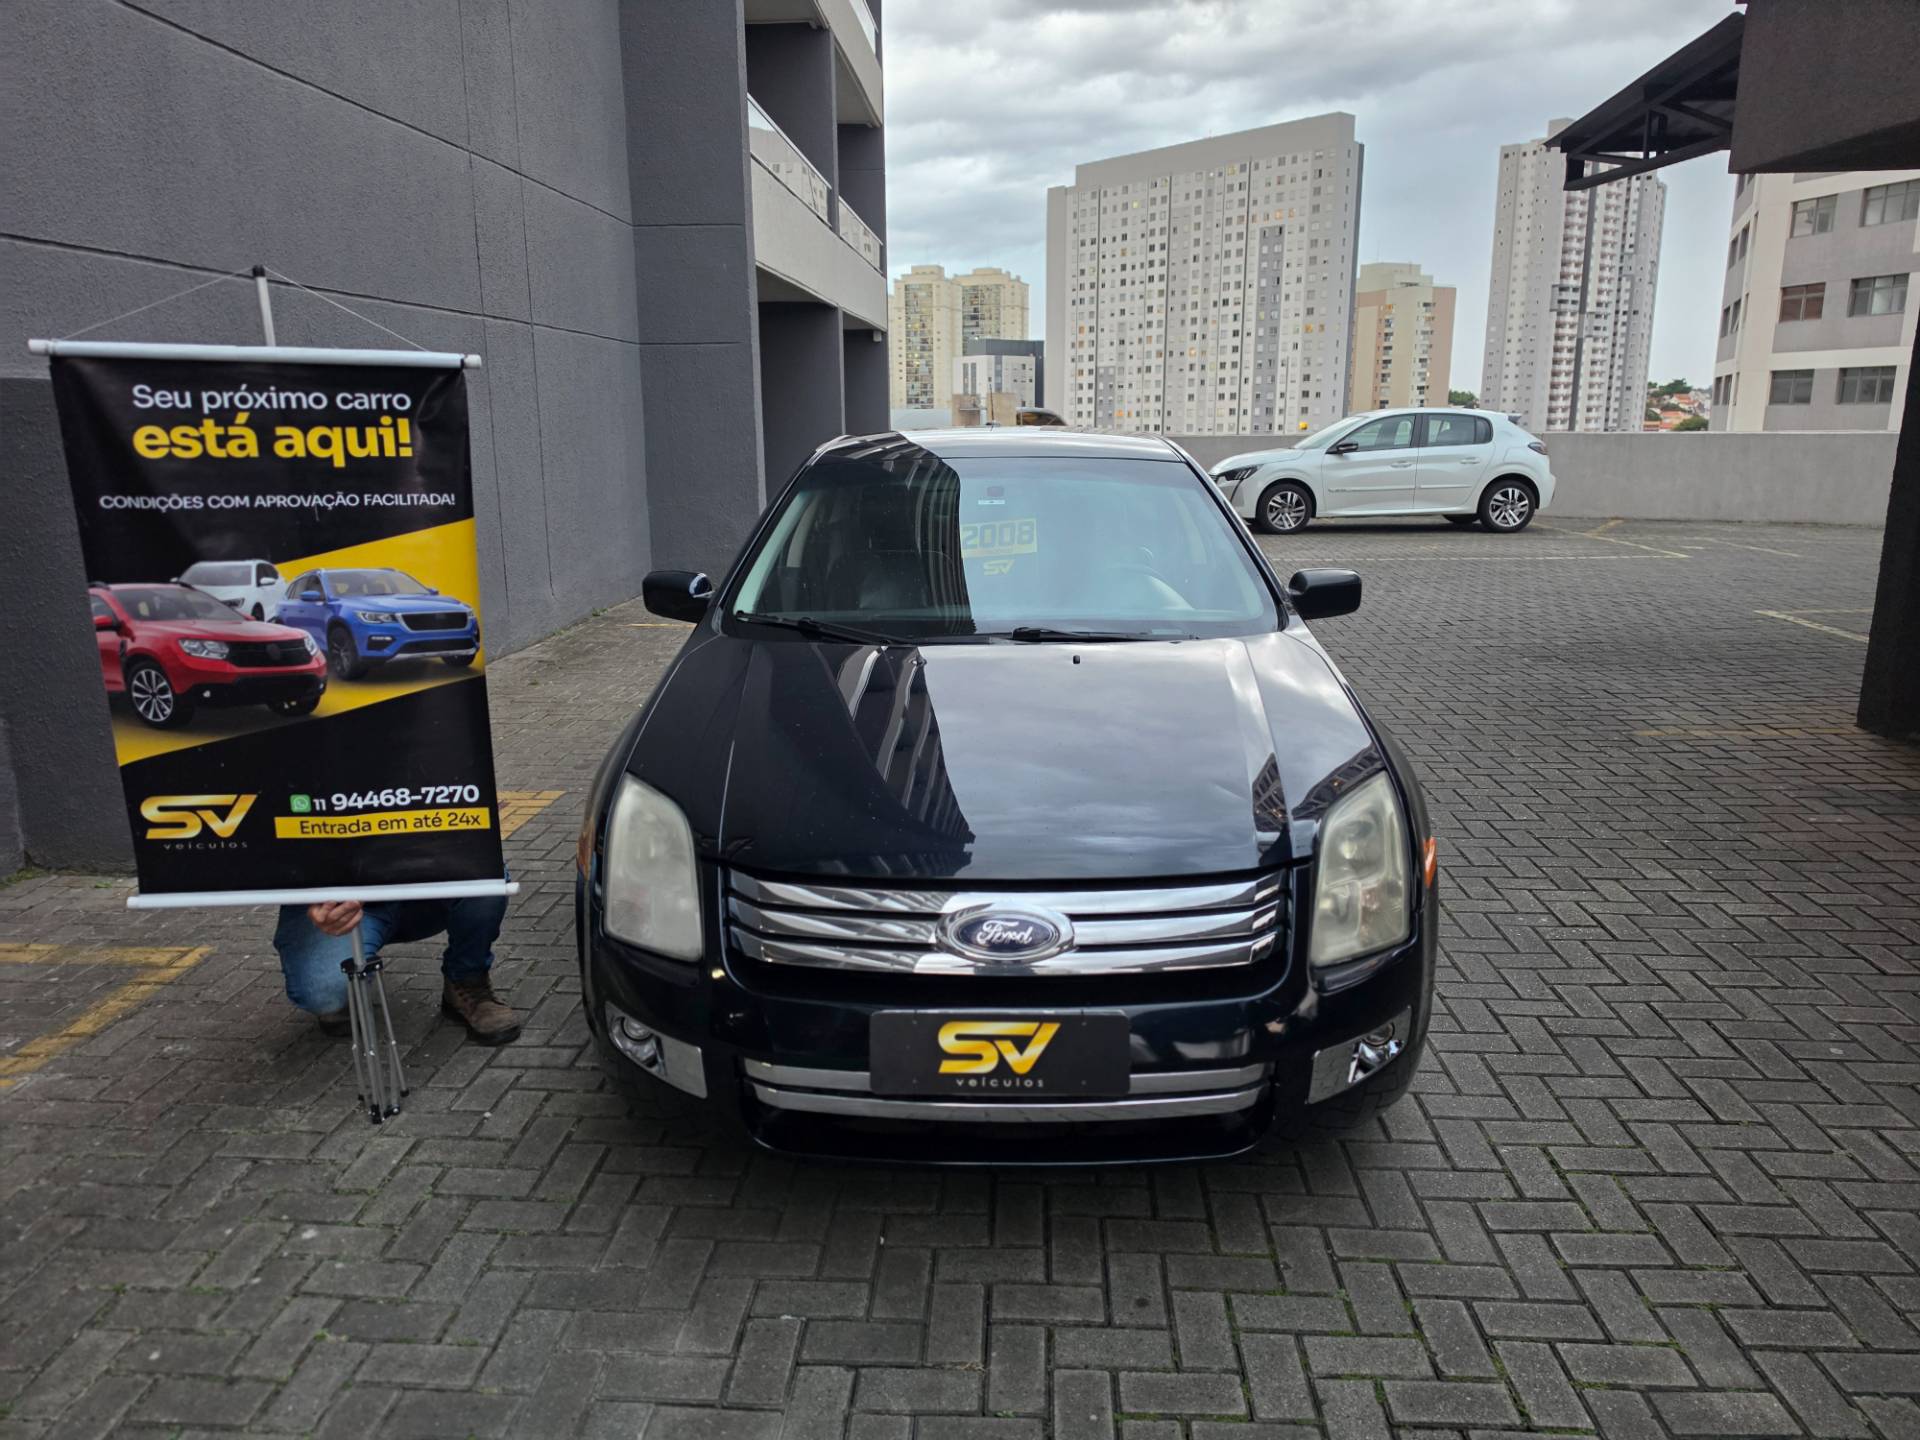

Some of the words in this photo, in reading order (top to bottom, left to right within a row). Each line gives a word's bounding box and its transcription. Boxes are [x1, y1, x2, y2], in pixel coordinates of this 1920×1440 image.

[132, 384, 192, 410] Seu
[201, 383, 328, 415] próximo
[335, 391, 412, 411] carro
[132, 412, 260, 460] está
[273, 415, 413, 468] aqui!
[99, 492, 204, 513] CONDIÇÕES
[207, 495, 250, 509] COM
[254, 491, 360, 510] APROVAÇÃO
[363, 493, 455, 506] FACILITADA!
[331, 784, 480, 811] 94468-7270
[140, 793, 259, 839] SV
[299, 816, 372, 836] Entrada
[377, 818, 408, 831] em
[412, 812, 443, 829] até
[447, 811, 481, 828] 24x
[976, 920, 1033, 945] Ford
[938, 1021, 1061, 1075] SV
